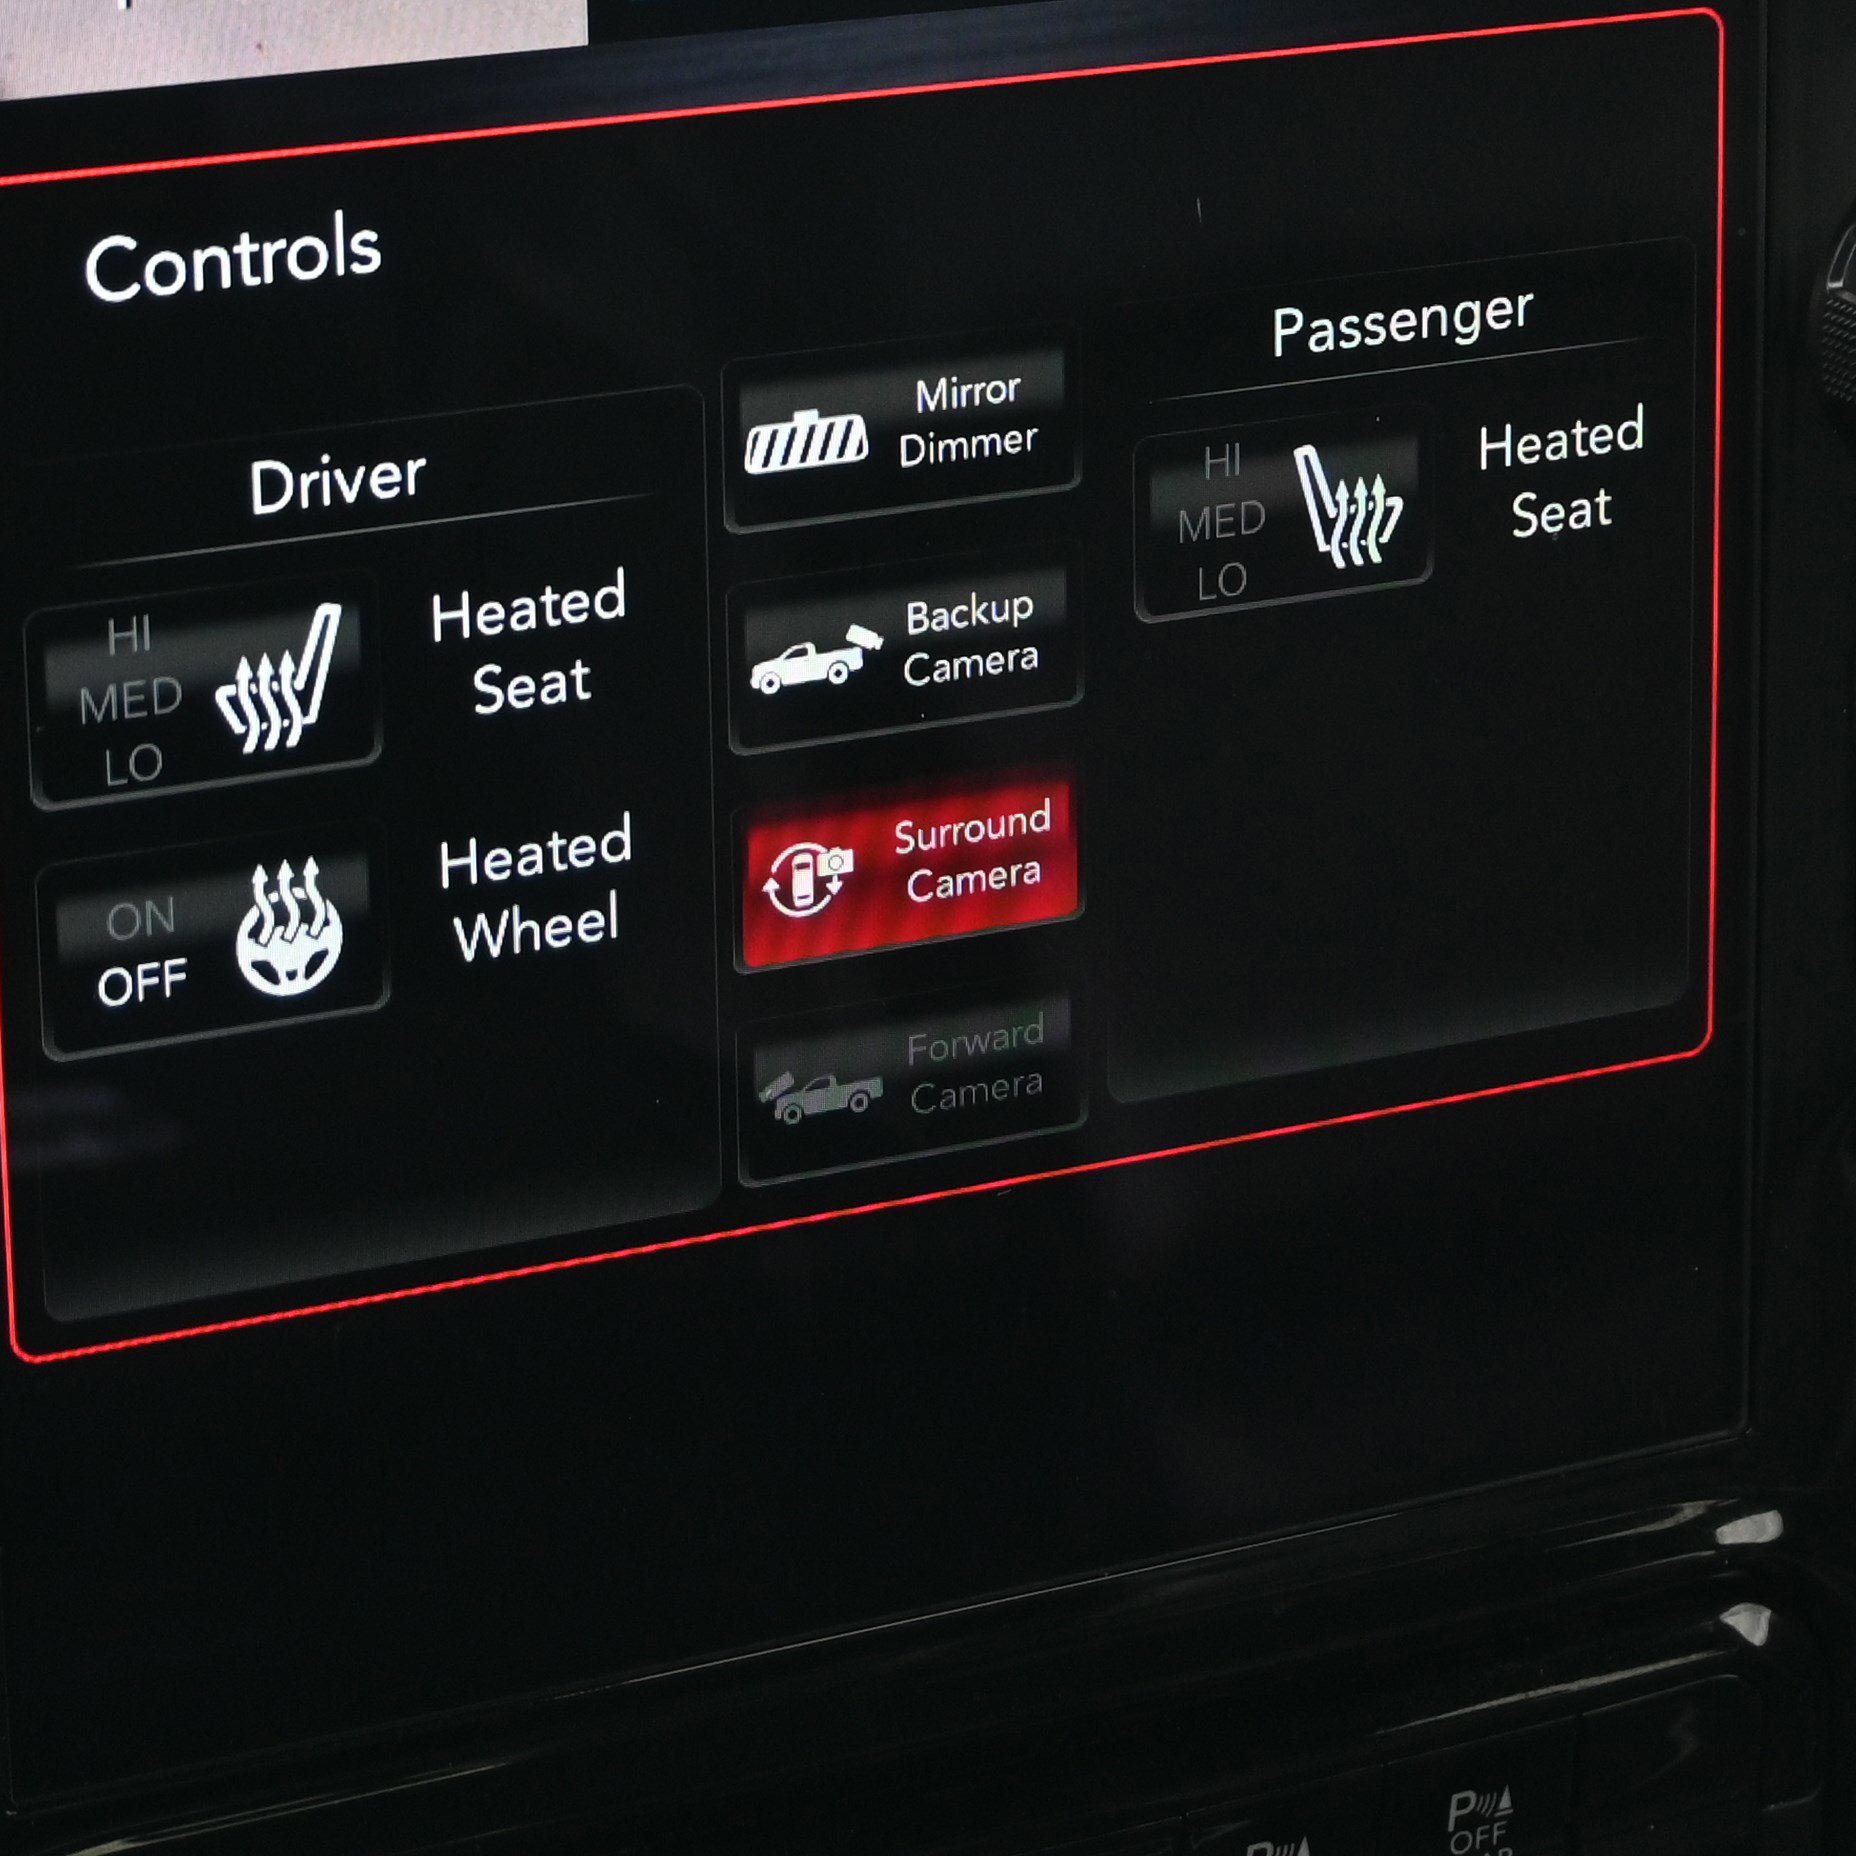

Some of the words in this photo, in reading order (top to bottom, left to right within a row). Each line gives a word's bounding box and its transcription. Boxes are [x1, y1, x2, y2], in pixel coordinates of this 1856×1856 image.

[85, 209, 383, 304] Controls
[1273, 286, 1535, 358] Passenger
[915, 372, 1022, 415] Mirror
[899, 425, 1040, 469] Dimmer
[1203, 441, 1242, 480] HI
[1479, 402, 1645, 471] Heated
[250, 453, 428, 516] Driver
[1177, 499, 1267, 544] MED
[1511, 486, 1613, 539] Seat
[431, 566, 627, 644] Heated
[1197, 561, 1249, 603] LO
[106, 613, 152, 656] HI
[906, 591, 1035, 638] Backup
[472, 658, 592, 716] Seat
[902, 646, 1040, 688] Camera
[79, 675, 183, 726] MED
[105, 742, 164, 787] LO
[440, 810, 633, 890] Heated
[894, 798, 1053, 856] Surround
[906, 857, 1042, 904] Camera
[106, 894, 176, 942] ON
[453, 890, 619, 963] Wheel
[97, 956, 188, 1008] OFF
[907, 1011, 1046, 1067] Forward
[910, 1068, 1044, 1116] Camera
[1449, 1820, 1508, 1855] OFF
